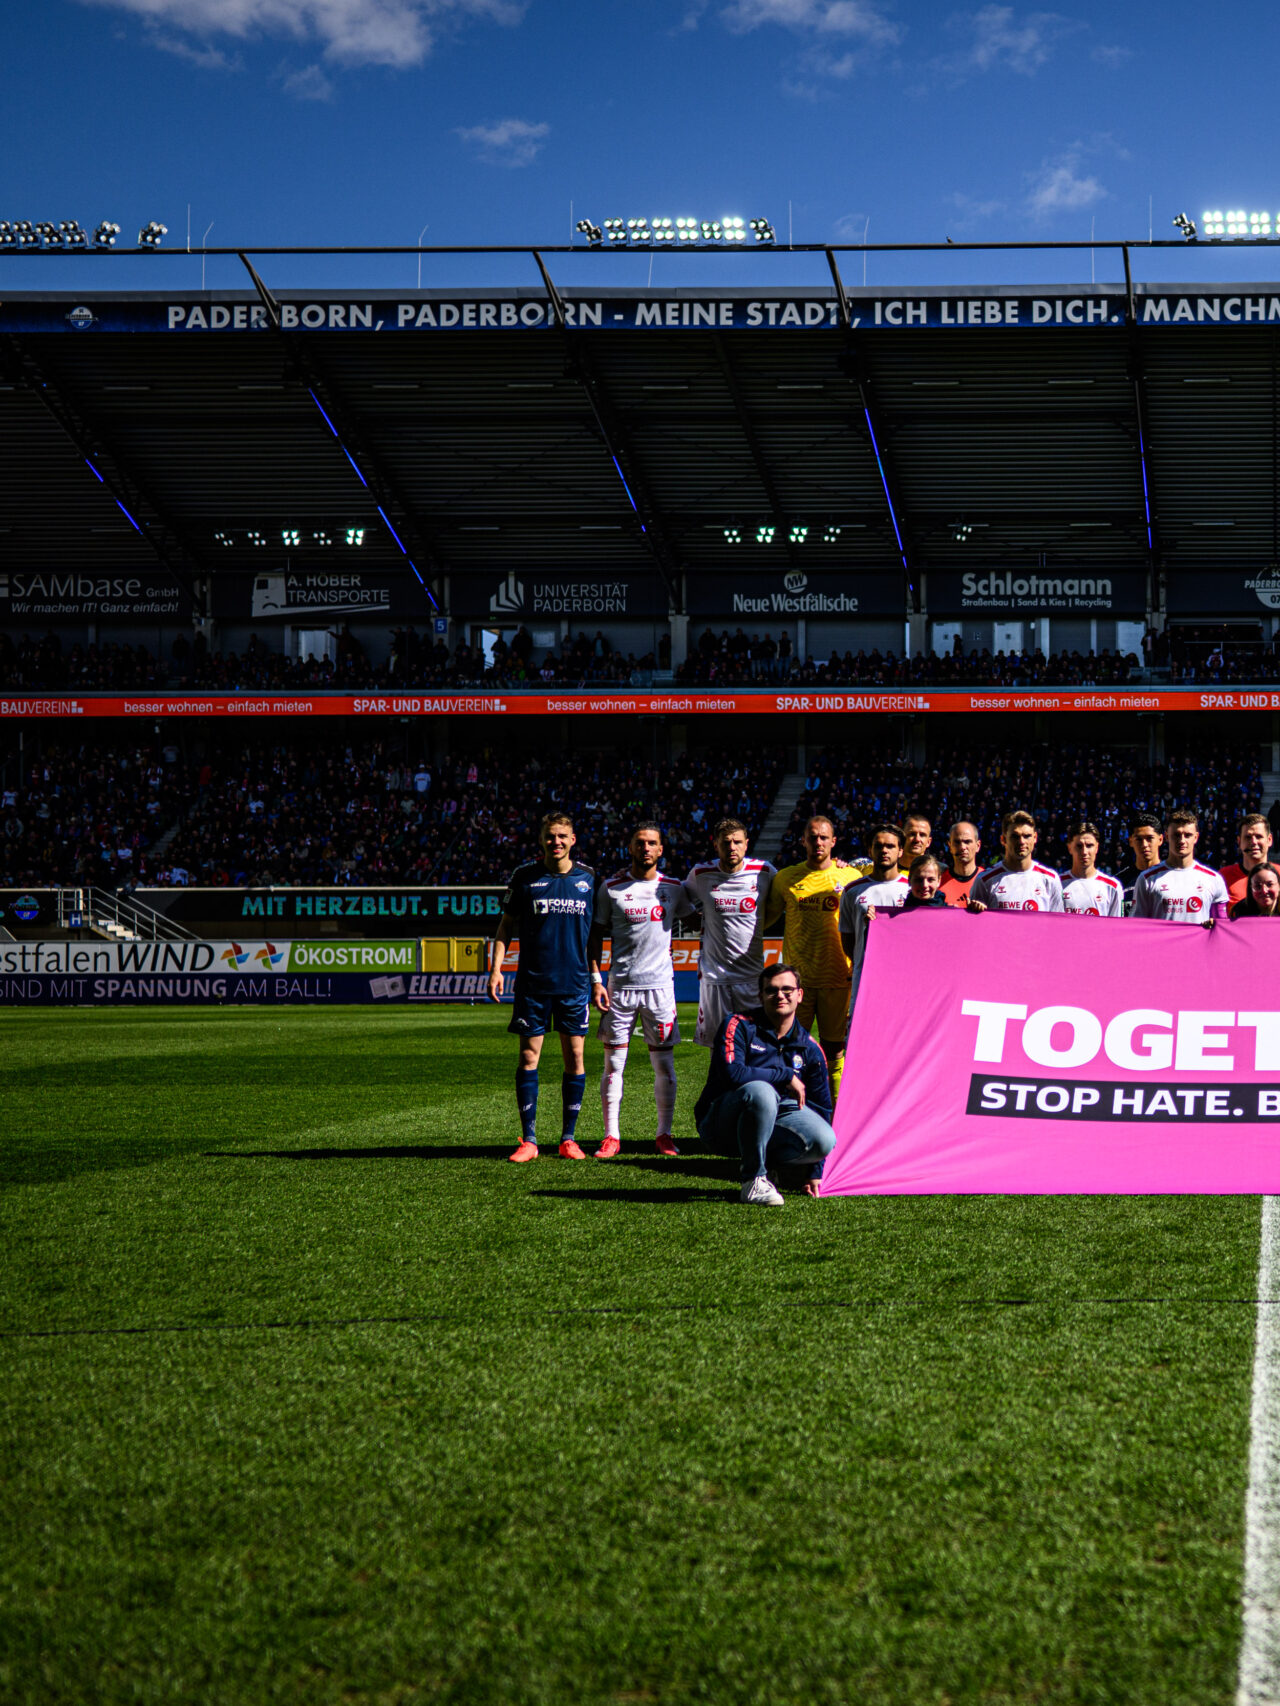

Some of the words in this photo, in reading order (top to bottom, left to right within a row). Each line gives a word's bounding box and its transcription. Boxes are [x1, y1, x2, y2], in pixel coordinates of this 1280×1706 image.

[167, 305, 384, 331] PADERBORN,
[397, 302, 602, 327] PADERBORN
[634, 302, 734, 326] MEINE
[873, 301, 928, 325] ICH
[940, 299, 1019, 324] LIEBE
[1032, 298, 1120, 324] DICH.
[12, 573, 142, 597] SAMbase
[145, 587, 179, 597] GmbH
[533, 581, 629, 598] UNIVERSITÄT
[961, 571, 1112, 596] Schlotmann
[288, 589, 390, 603] TRANSPORTE
[733, 593, 770, 612] Neue
[770, 593, 859, 612] Westfälische
[11, 602, 31, 613] Wir
[34, 602, 79, 613] machen
[100, 602, 130, 613] Ganz
[133, 602, 179, 613] einfach!
[533, 599, 626, 612] PADERBORN
[437, 620, 445, 631] 5
[124, 700, 163, 713] besser
[167, 700, 212, 713] wohnen
[227, 700, 271, 713] einfach
[273, 700, 312, 713] mieten
[353, 699, 390, 713] SPAR-
[393, 699, 420, 713] UND
[424, 699, 494, 713] BAUVEREIN
[547, 698, 587, 711] besser
[590, 698, 635, 711] wohnen
[650, 698, 693, 711] einfach
[696, 698, 735, 711] mieten
[776, 696, 813, 710] SPAR-
[816, 696, 843, 710] UND
[847, 696, 917, 710] BAUVEREIN
[970, 696, 1010, 709] besser
[1013, 696, 1059, 709] wohnen
[1074, 696, 1116, 709] einfach
[1119, 696, 1159, 709] mieten
[1200, 694, 1237, 708] SPAR-
[1240, 694, 1267, 708] UND
[241, 896, 288, 916] MIT
[295, 896, 429, 916] HERZBLUT.
[548, 899, 575, 908] FOUR
[575, 901, 587, 909] 20
[715, 898, 737, 906] REWE
[71, 913, 81, 925] H
[625, 908, 647, 916] REWE
[0, 942, 215, 972] stfalenWIND
[294, 945, 413, 966] ÖKOSTROM!
[465, 945, 472, 956] 6
[51, 979, 88, 998] MIT
[93, 978, 227, 998] SPANNUNG
[234, 979, 268, 998] AM
[275, 979, 332, 998] BALL!
[658, 1022, 674, 1042] 17
[980, 1081, 1100, 1114] STOP
[1112, 1087, 1244, 1118] HATE.
